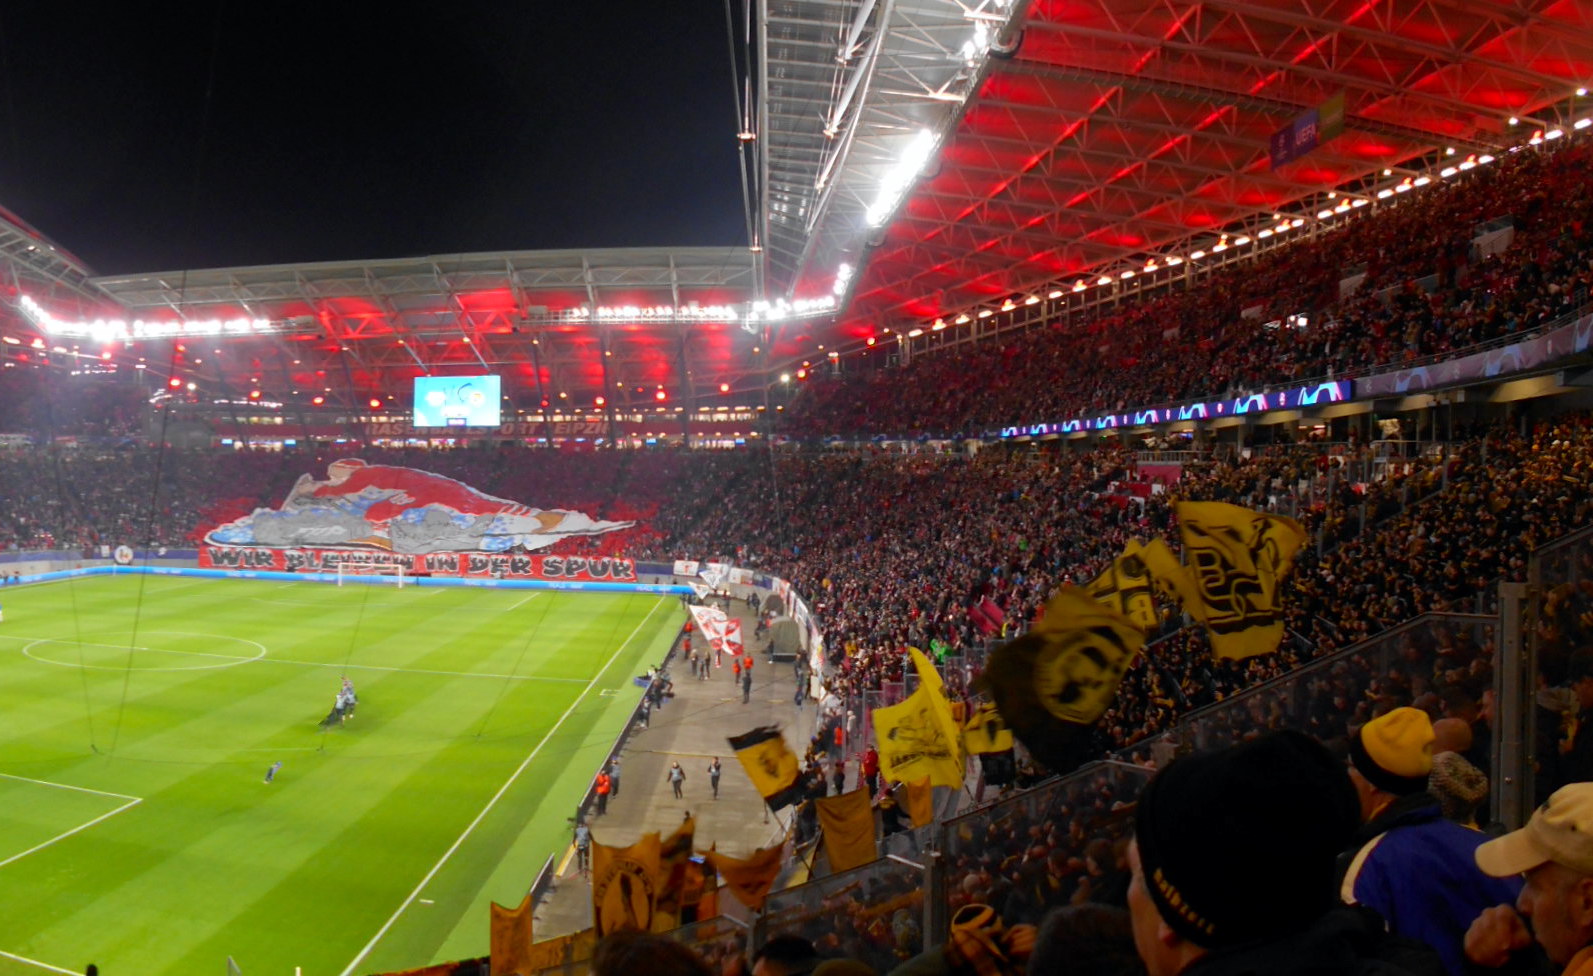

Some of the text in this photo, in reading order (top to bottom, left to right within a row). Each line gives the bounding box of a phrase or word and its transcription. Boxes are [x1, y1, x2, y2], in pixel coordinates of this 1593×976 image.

[209, 549, 275, 567] WIR
[425, 555, 459, 572] IN
[468, 554, 533, 576] DER
[542, 556, 634, 579] SPUR
